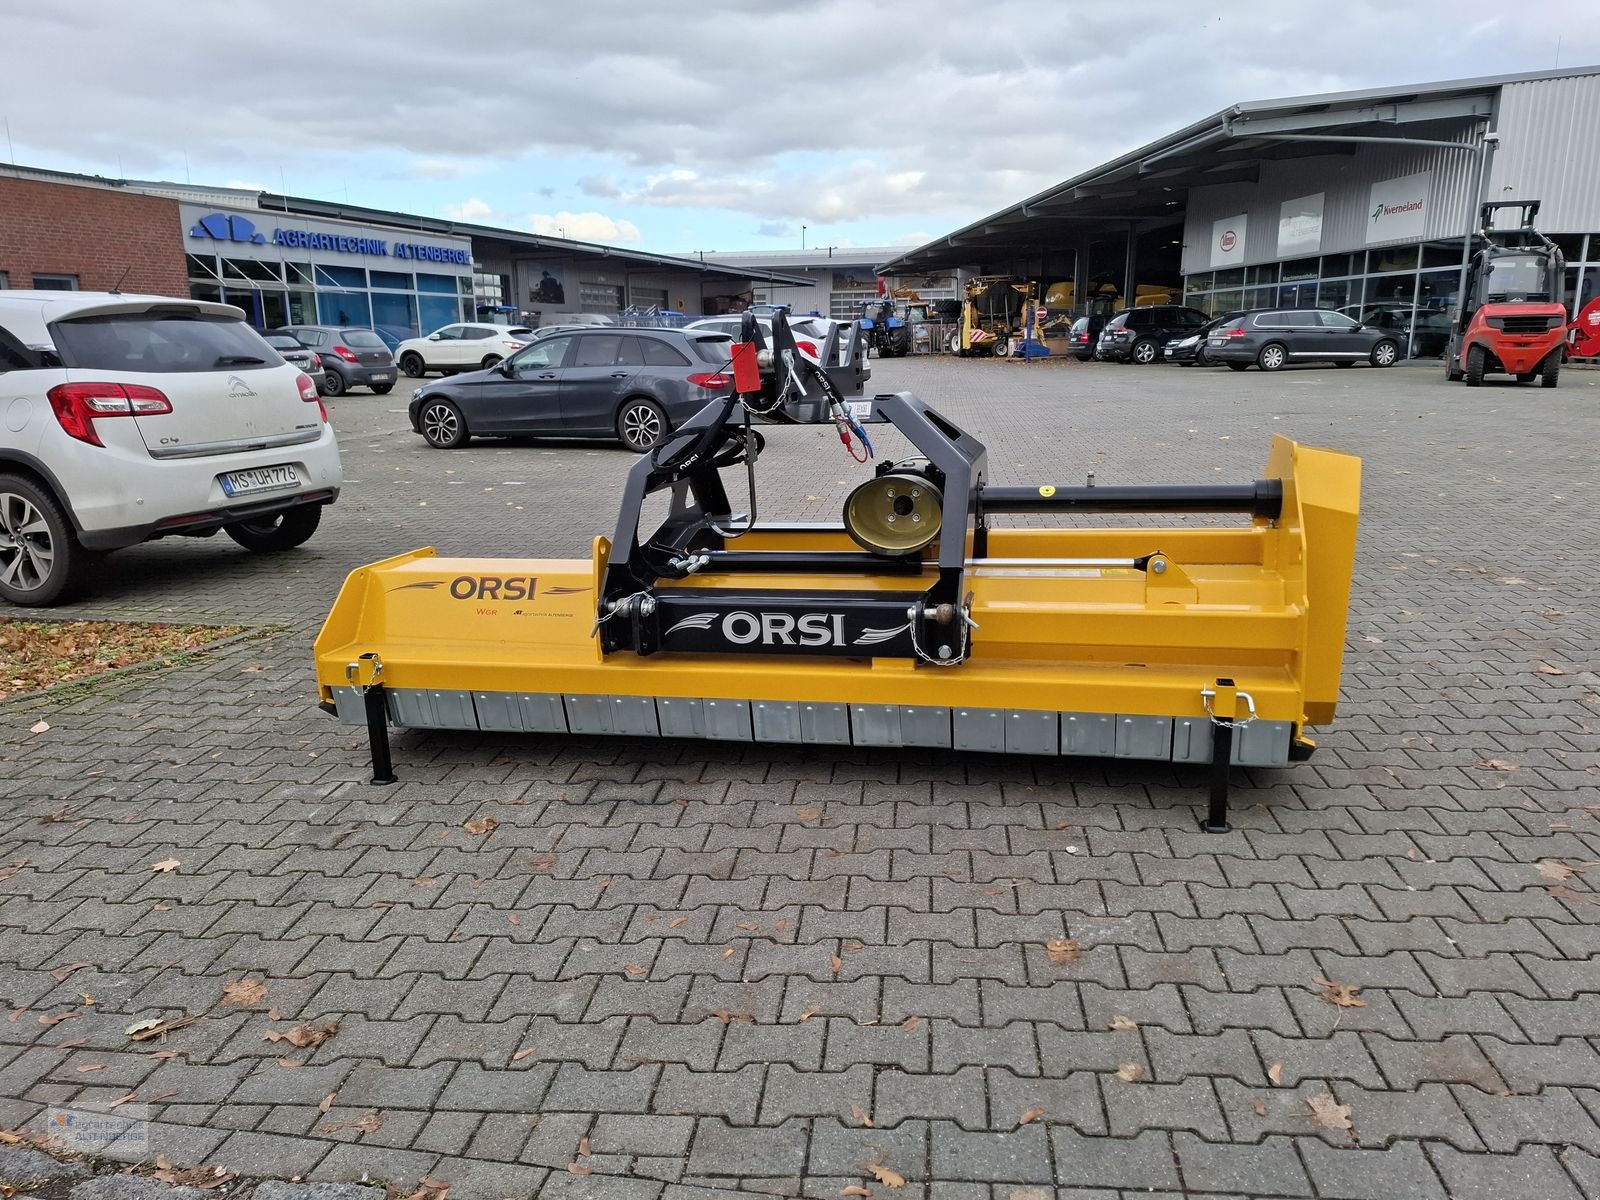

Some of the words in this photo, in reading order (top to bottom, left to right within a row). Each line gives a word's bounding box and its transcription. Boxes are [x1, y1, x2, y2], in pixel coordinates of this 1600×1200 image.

[1383, 198, 1423, 216] Kverneland
[273, 228, 389, 256] AGRARTECHNIK
[394, 242, 473, 265] ALTENBERGE
[228, 474, 250, 489] MS
[450, 575, 538, 601] ORSI
[721, 610, 847, 647] ORSI
